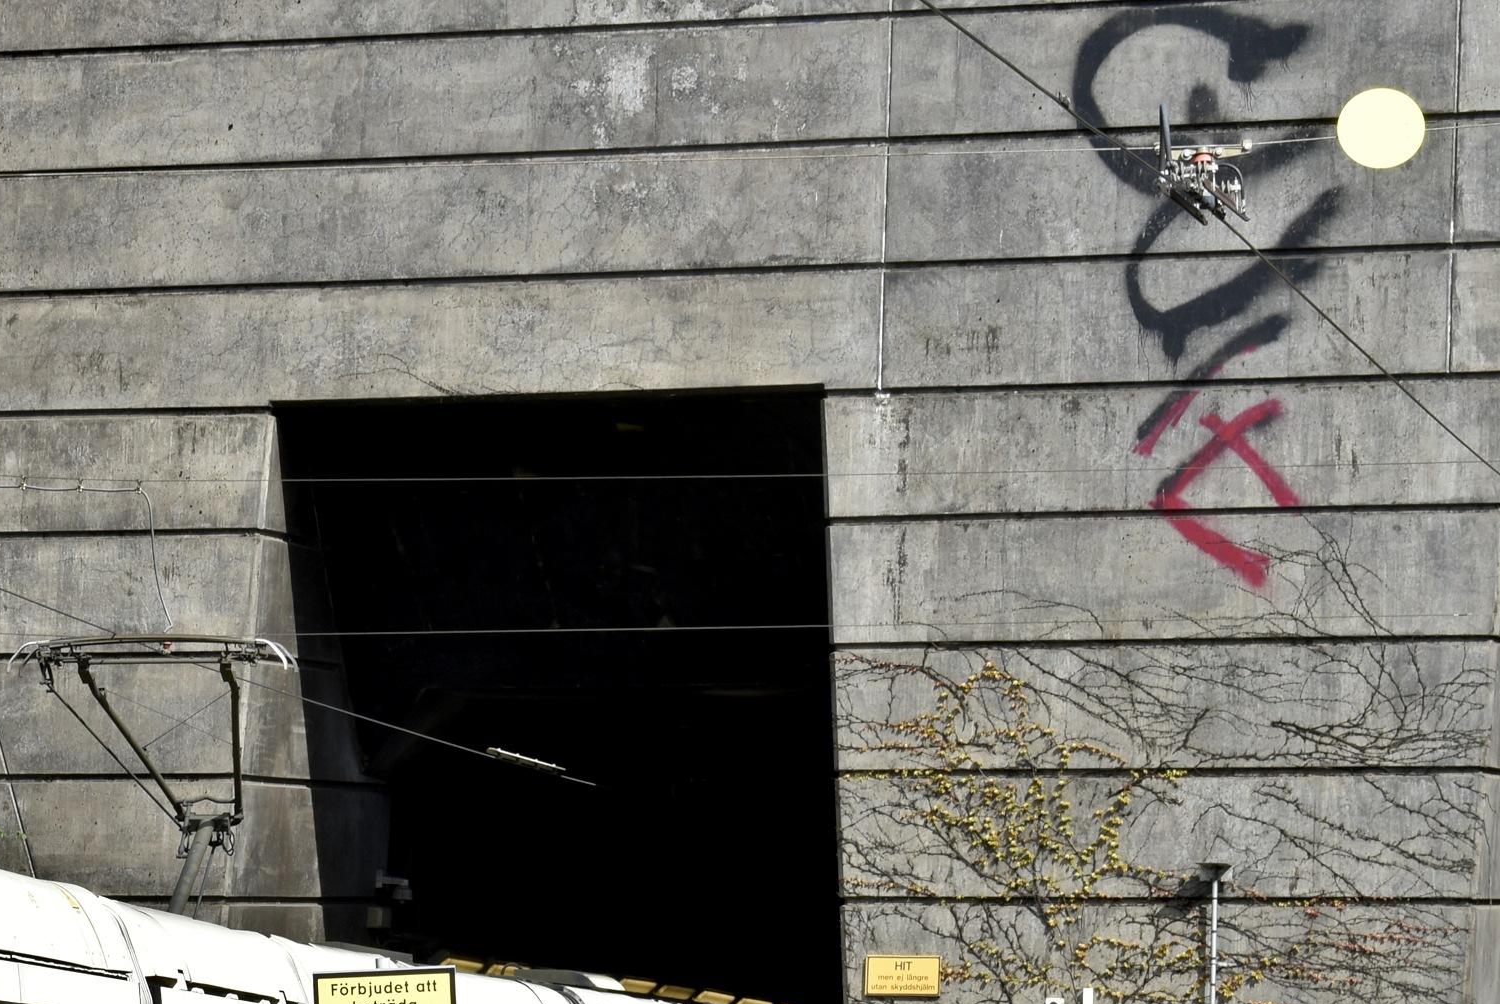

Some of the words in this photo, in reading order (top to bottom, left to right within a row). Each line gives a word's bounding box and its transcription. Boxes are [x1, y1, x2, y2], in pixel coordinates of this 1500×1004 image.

[895, 961, 913, 971] HIT
[897, 974, 904, 982] ej
[907, 974, 929, 983] längre
[331, 981, 409, 998] Förbjudet
[416, 979, 438, 993] att
[891, 983, 936, 992] skyddshjälm
